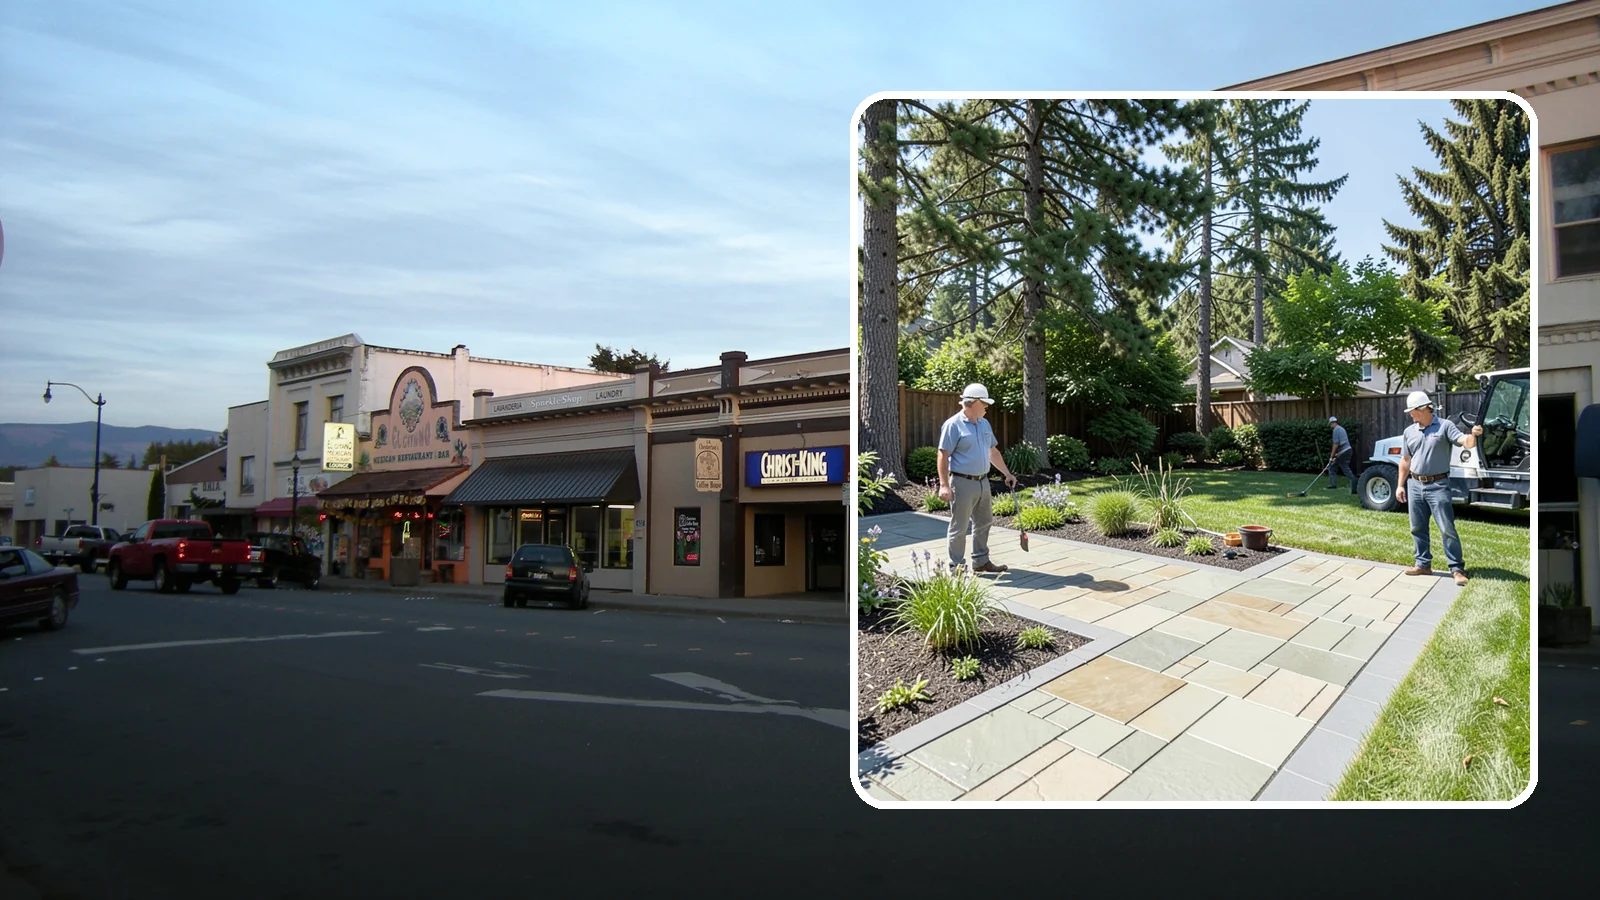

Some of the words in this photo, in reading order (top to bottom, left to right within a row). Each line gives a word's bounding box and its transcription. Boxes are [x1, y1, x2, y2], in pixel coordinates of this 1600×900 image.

[530, 396, 561, 408] Sparkle
[562, 394, 582, 406] Shop
[595, 389, 623, 399] LAUNDRY
[493, 402, 522, 412] LAVANDERIA
[373, 456, 396, 464] MEXICAN
[397, 451, 433, 461] RESTAURANT
[438, 450, 450, 458] BAR
[761, 452, 797, 478] CHRIST
[799, 450, 828, 477] KING
